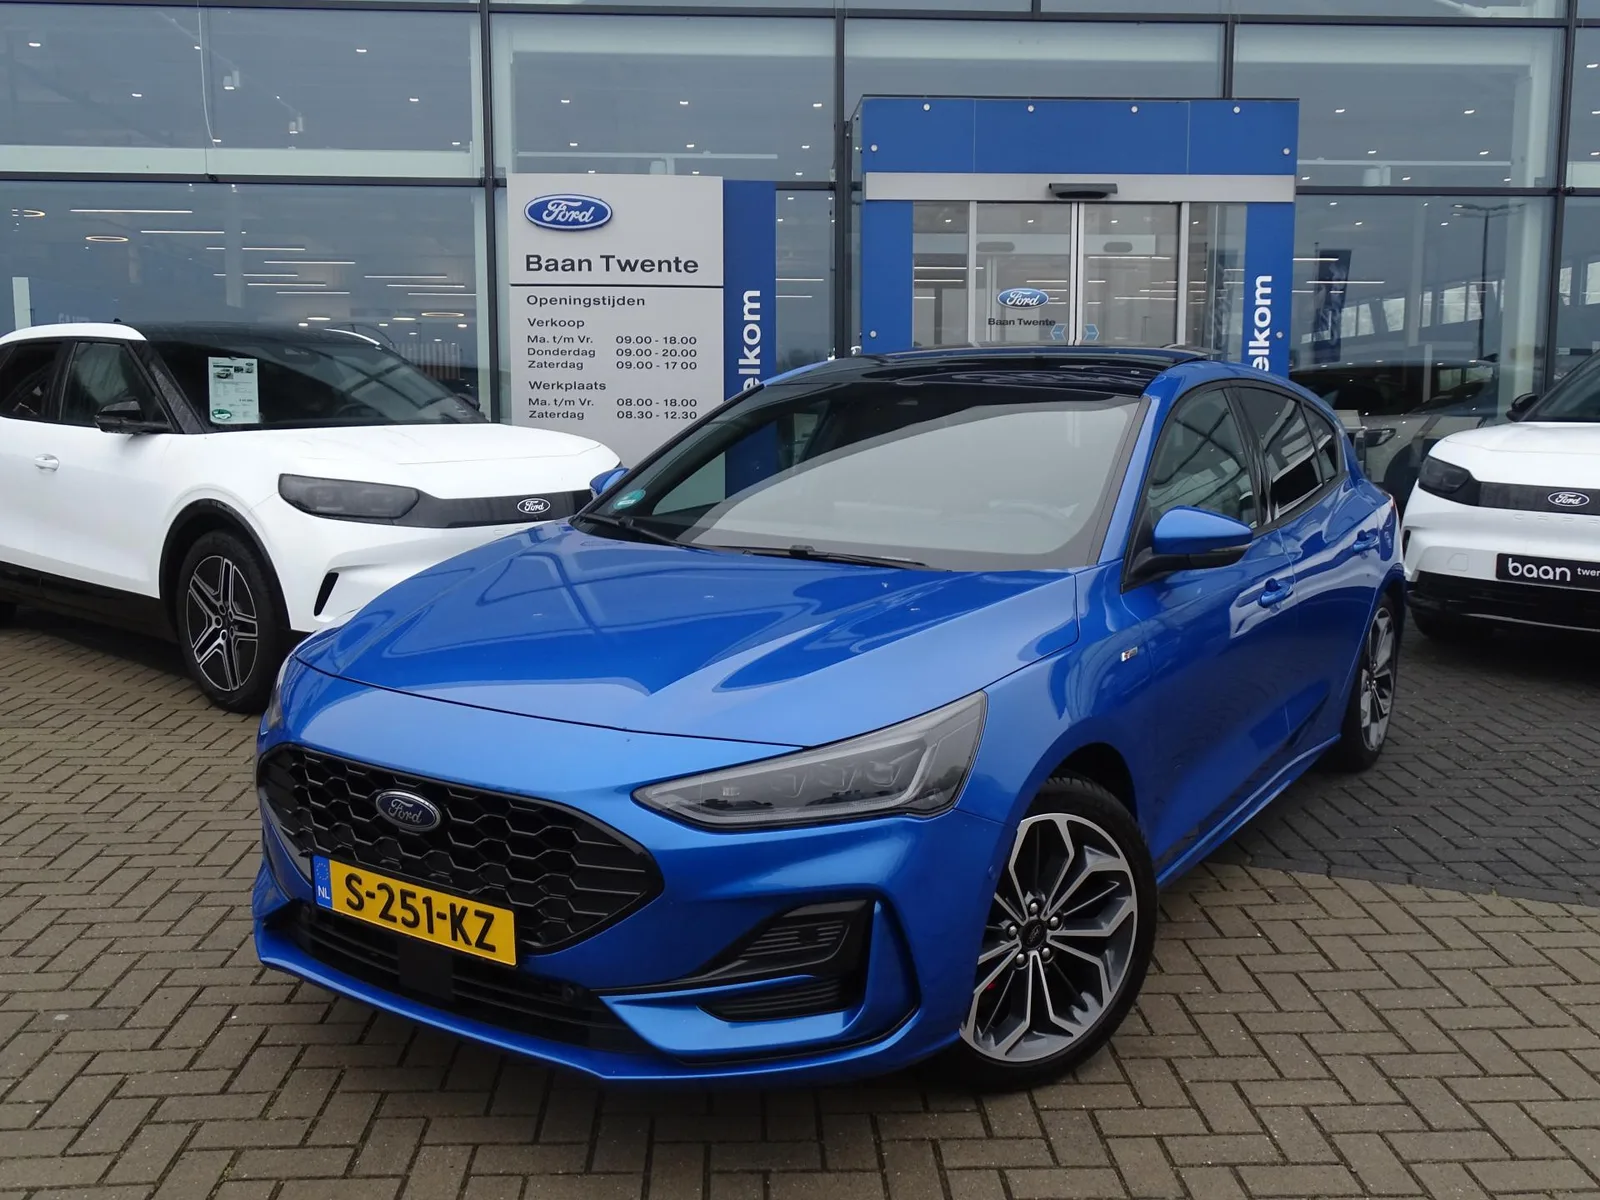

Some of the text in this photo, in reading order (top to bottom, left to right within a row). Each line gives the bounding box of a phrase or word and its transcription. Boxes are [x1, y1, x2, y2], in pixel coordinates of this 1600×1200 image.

[526, 254, 699, 274] Baan Twente
[527, 295, 645, 308] Openingstijden
[527, 317, 585, 329] Verkoop
[987, 317, 1056, 327] Baan Twente
[1248, 275, 1272, 372] elkom
[527, 335, 593, 344] Ma. t/m Vr.
[615, 335, 652, 345] 09.00
[662, 336, 697, 345] 18.00
[527, 347, 596, 358] Donderdag
[616, 348, 652, 357] 09.00
[661, 349, 697, 358] 20.00
[527, 360, 584, 371] Zaterdag
[616, 361, 653, 370] 09.00
[528, 380, 607, 391] Werkplaats
[528, 397, 594, 407] Ma. t/m Vr.
[616, 398, 653, 407] 08.00
[663, 398, 697, 407] 18.00
[528, 410, 585, 420] Zaterdag
[617, 410, 653, 419] 08.30
[664, 411, 697, 420] 12.30
[1508, 557, 1571, 582] baan
[317, 885, 331, 900] NL
[344, 872, 497, 953] S-251-KZ
